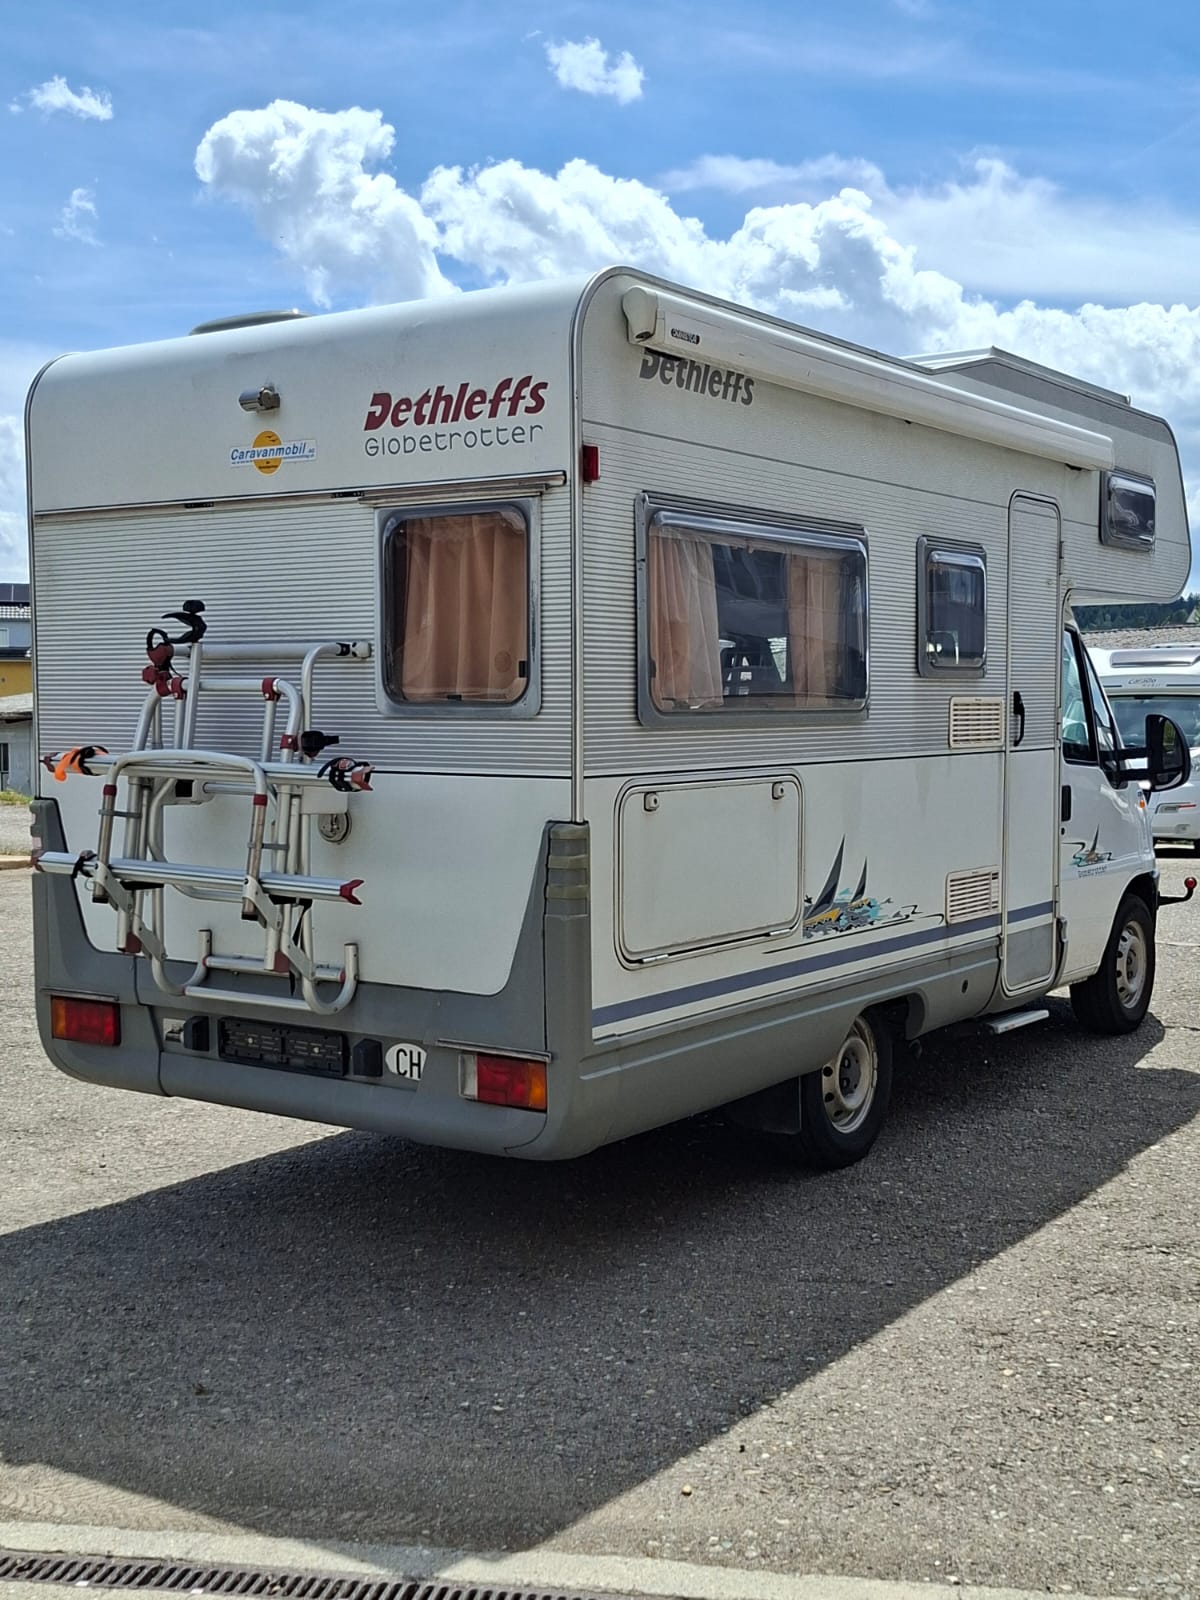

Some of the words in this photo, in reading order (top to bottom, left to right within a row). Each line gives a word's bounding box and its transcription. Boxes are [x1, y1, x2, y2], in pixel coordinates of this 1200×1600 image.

[364, 375, 549, 431] Dethleffs
[231, 442, 307, 461] Caravanmobil
[364, 424, 544, 457] Globetrotter
[397, 1049, 421, 1079] CH
